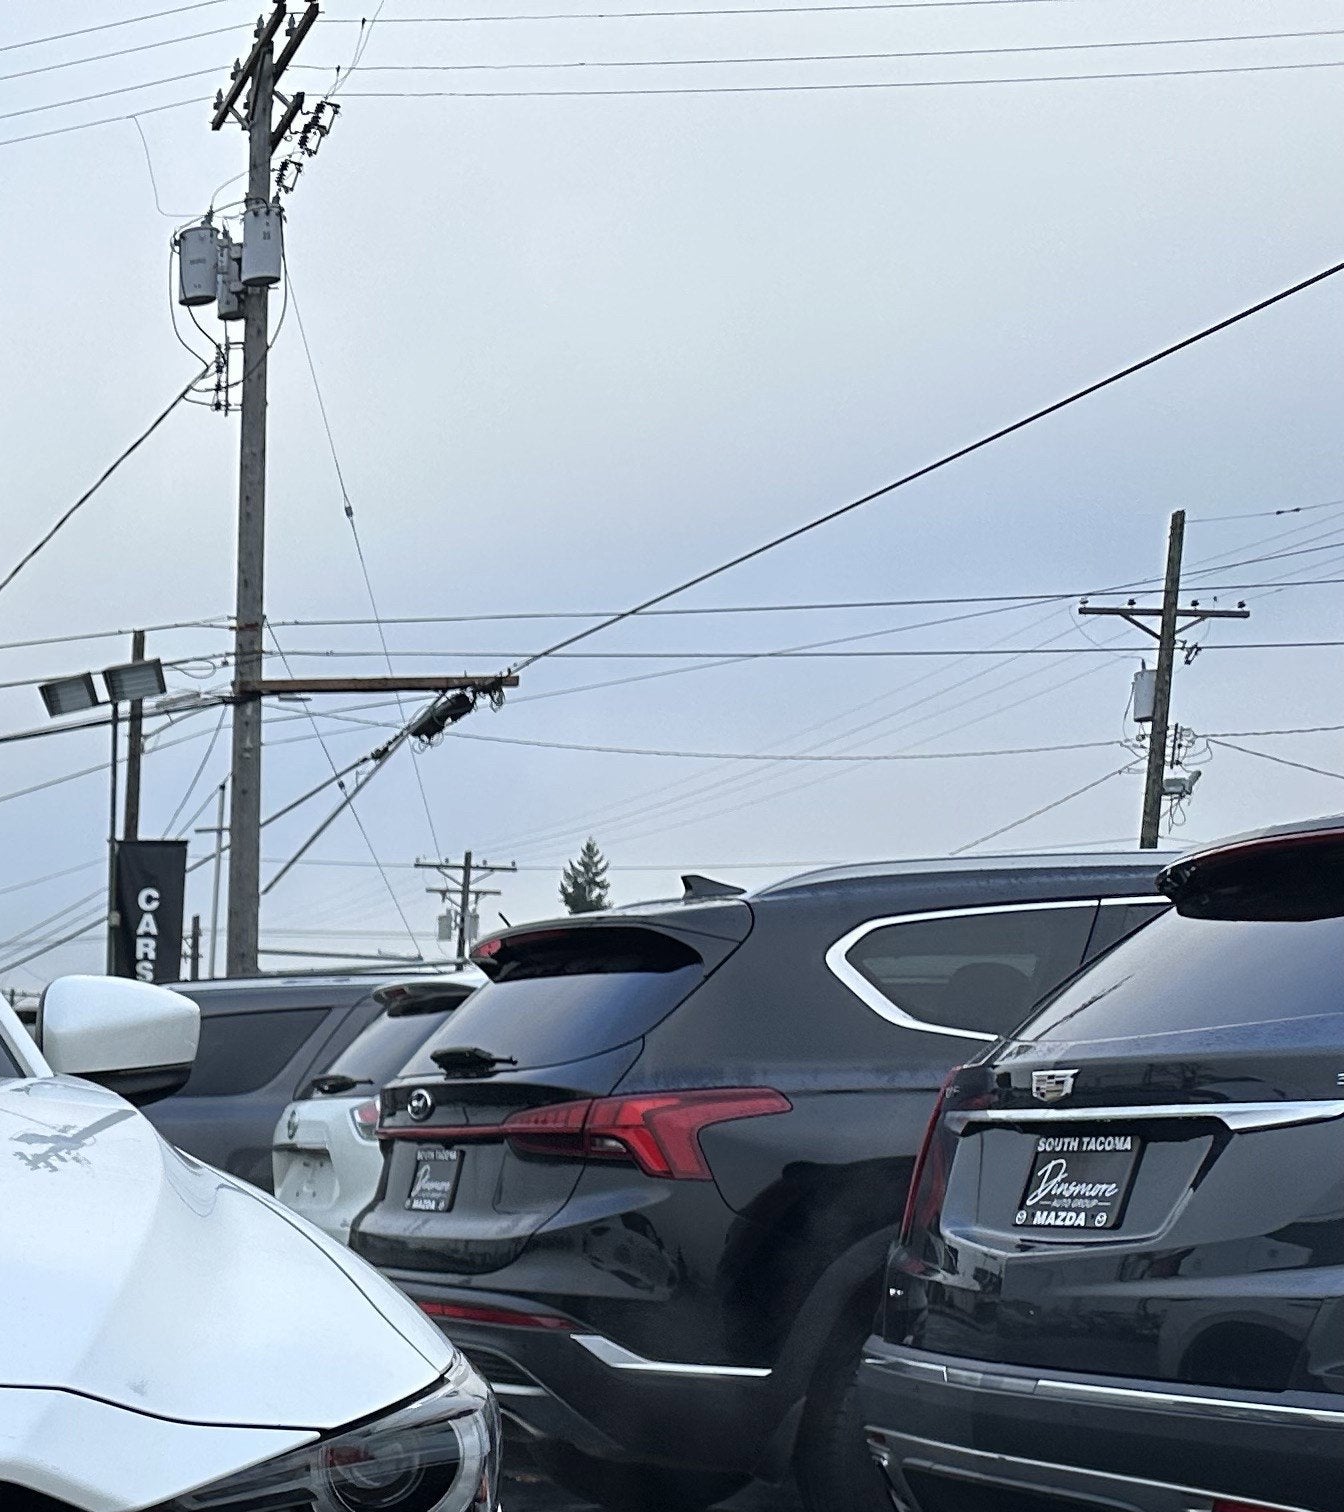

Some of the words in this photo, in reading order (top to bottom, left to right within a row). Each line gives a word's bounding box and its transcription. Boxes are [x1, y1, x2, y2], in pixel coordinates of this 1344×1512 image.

[135, 887, 160, 982] CARS
[1037, 1137, 1080, 1152] SOUTH
[1081, 1136, 1132, 1151] TACOMA
[1025, 1158, 1119, 1206] Dinsmore
[1032, 1210, 1086, 1227] MAZDA
